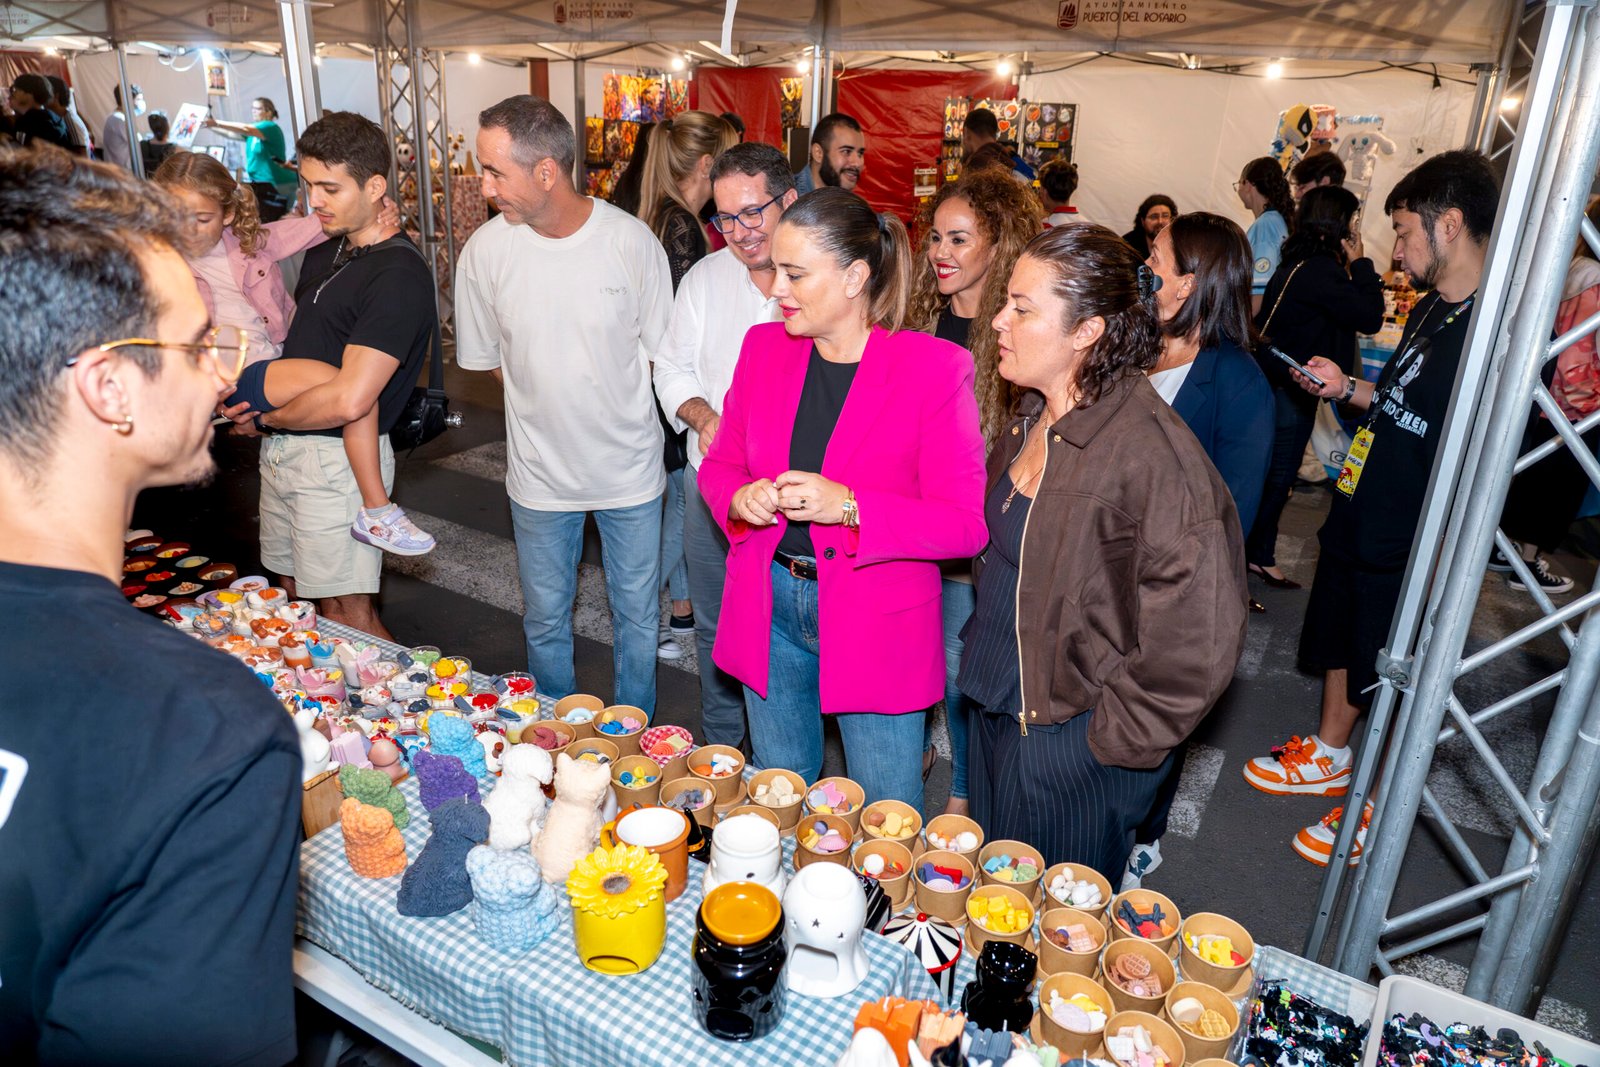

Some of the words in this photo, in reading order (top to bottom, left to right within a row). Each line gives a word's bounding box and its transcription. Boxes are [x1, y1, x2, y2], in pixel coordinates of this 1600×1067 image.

[1085, 1, 1187, 10] AYUNTAMIENTO
[1083, 11, 1120, 22] PUERTO
[1122, 11, 1140, 22] DEL
[1144, 12, 1187, 23] ROSARIO
